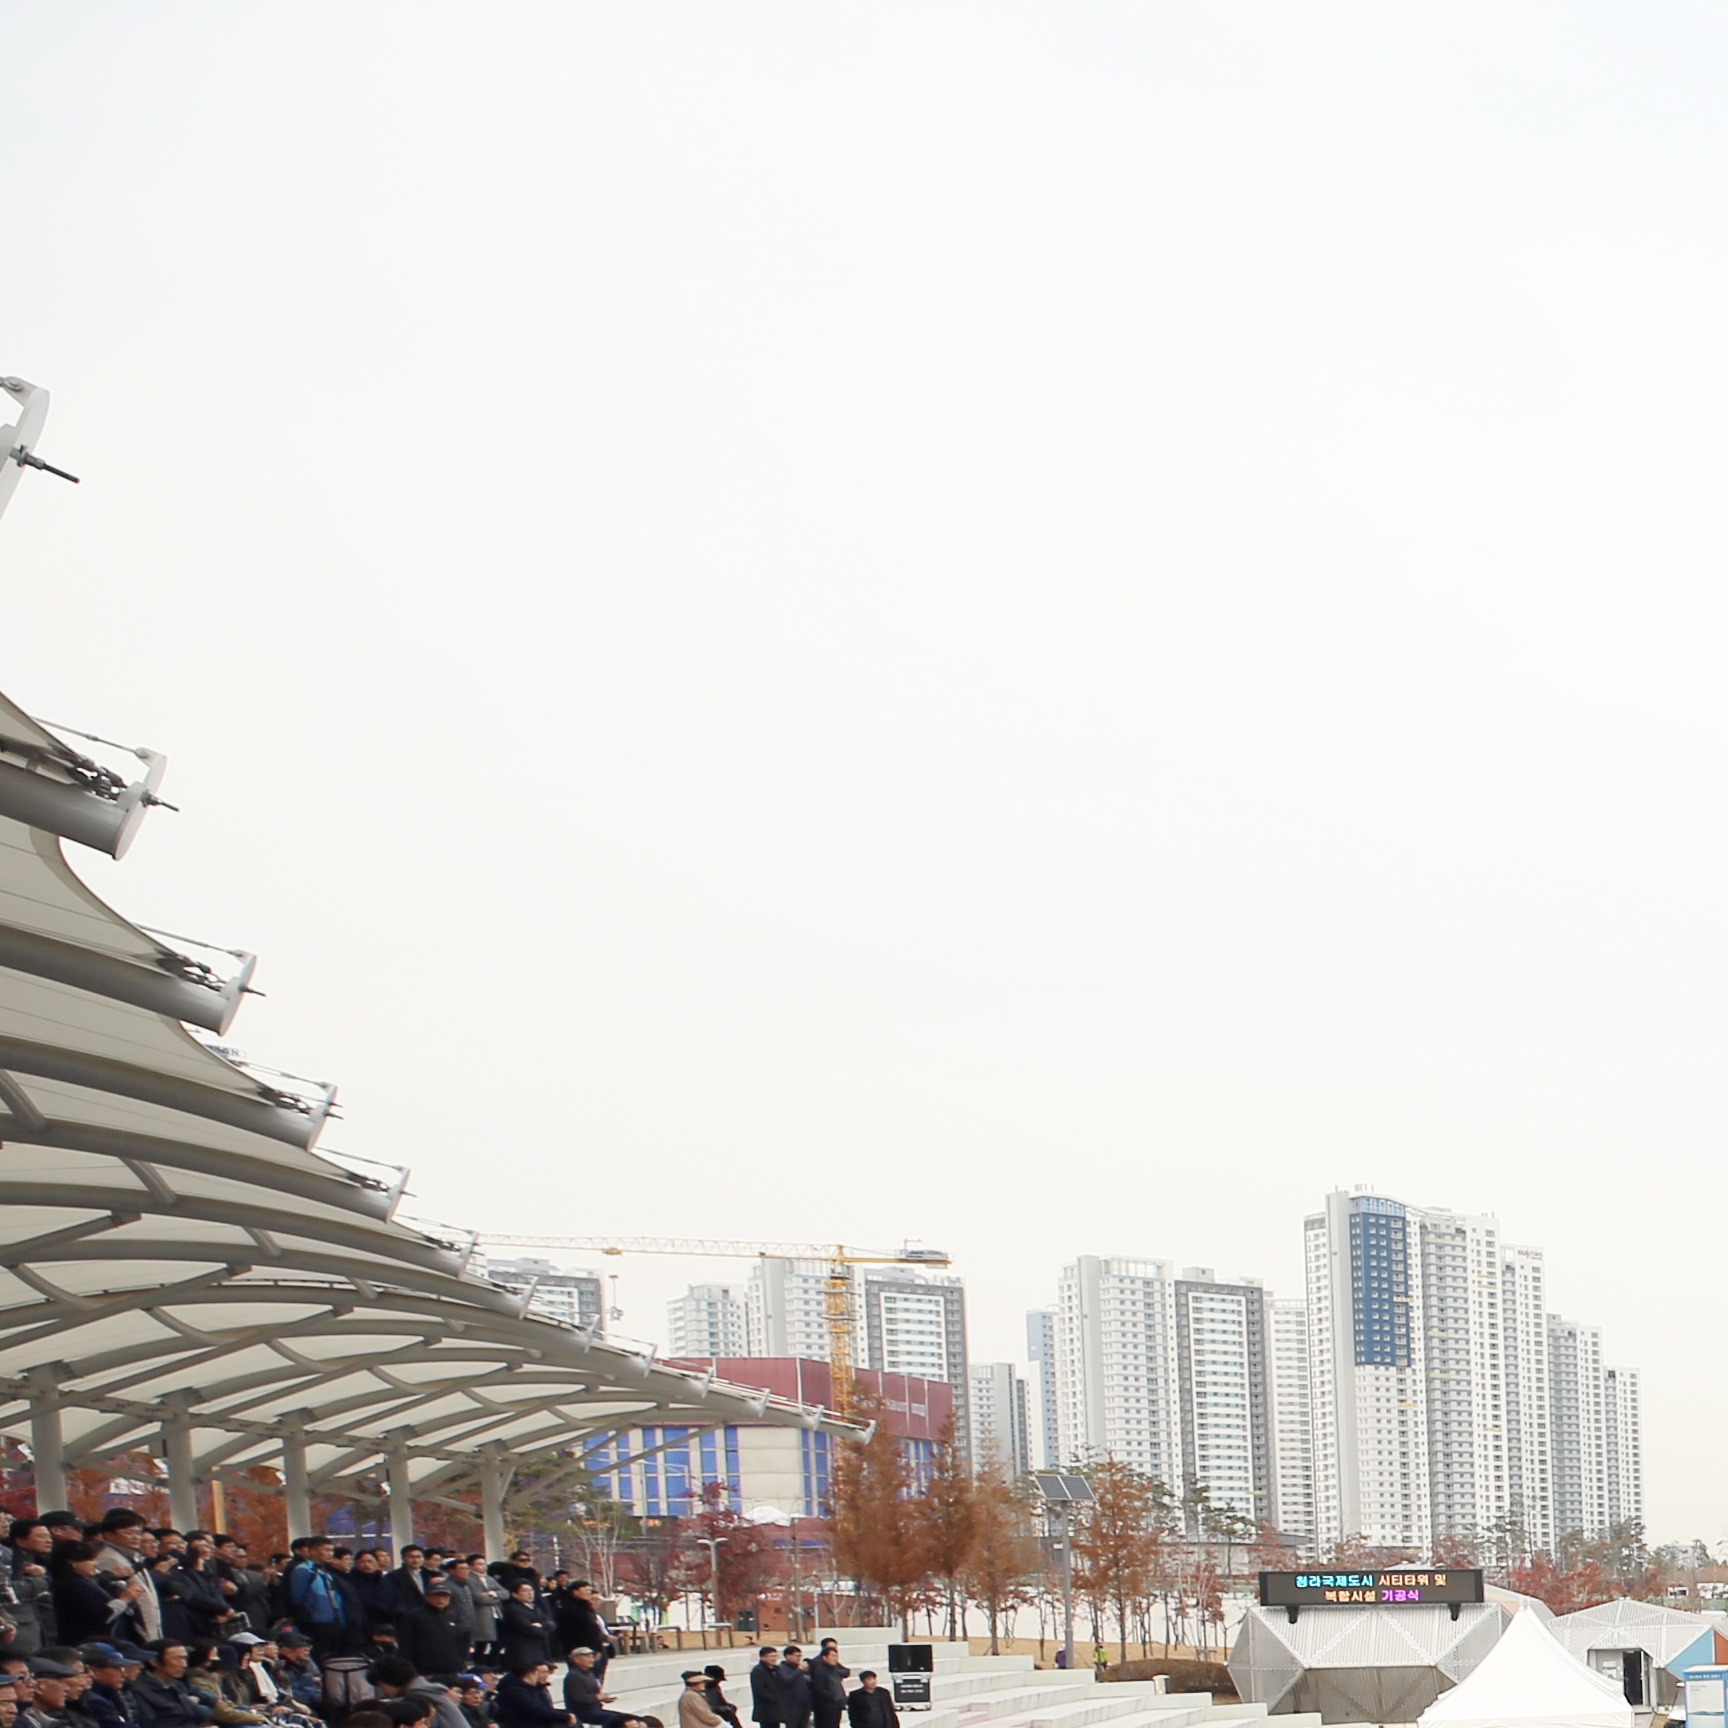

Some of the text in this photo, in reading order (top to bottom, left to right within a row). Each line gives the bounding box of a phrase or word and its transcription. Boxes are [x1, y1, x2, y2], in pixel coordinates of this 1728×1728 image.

[1295, 1575, 1374, 1588] 청라국제도시
[1378, 1574, 1430, 1587] 시티타워
[1381, 1589, 1421, 1602] 기공식
